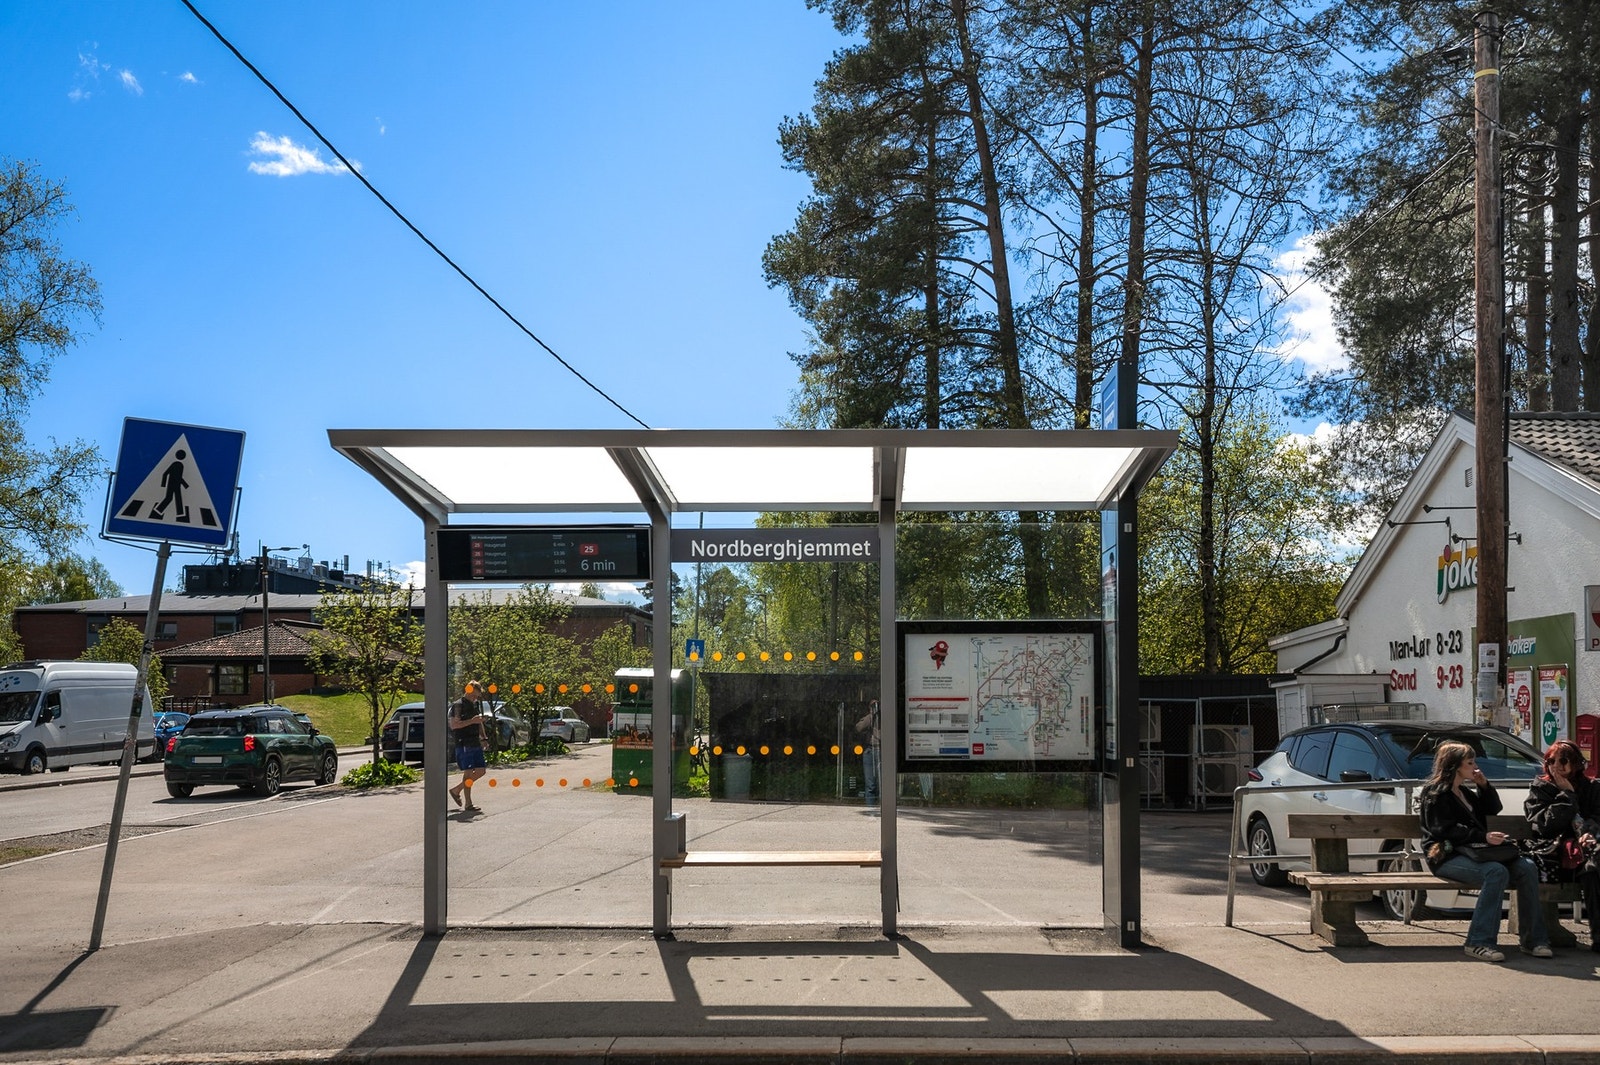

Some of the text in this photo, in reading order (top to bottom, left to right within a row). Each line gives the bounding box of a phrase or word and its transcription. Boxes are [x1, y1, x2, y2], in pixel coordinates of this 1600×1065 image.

[584, 545, 594, 554] 25
[691, 539, 871, 561] Nordberghjemmet
[581, 559, 616, 571] 6 min
[1438, 540, 1478, 605] joke
